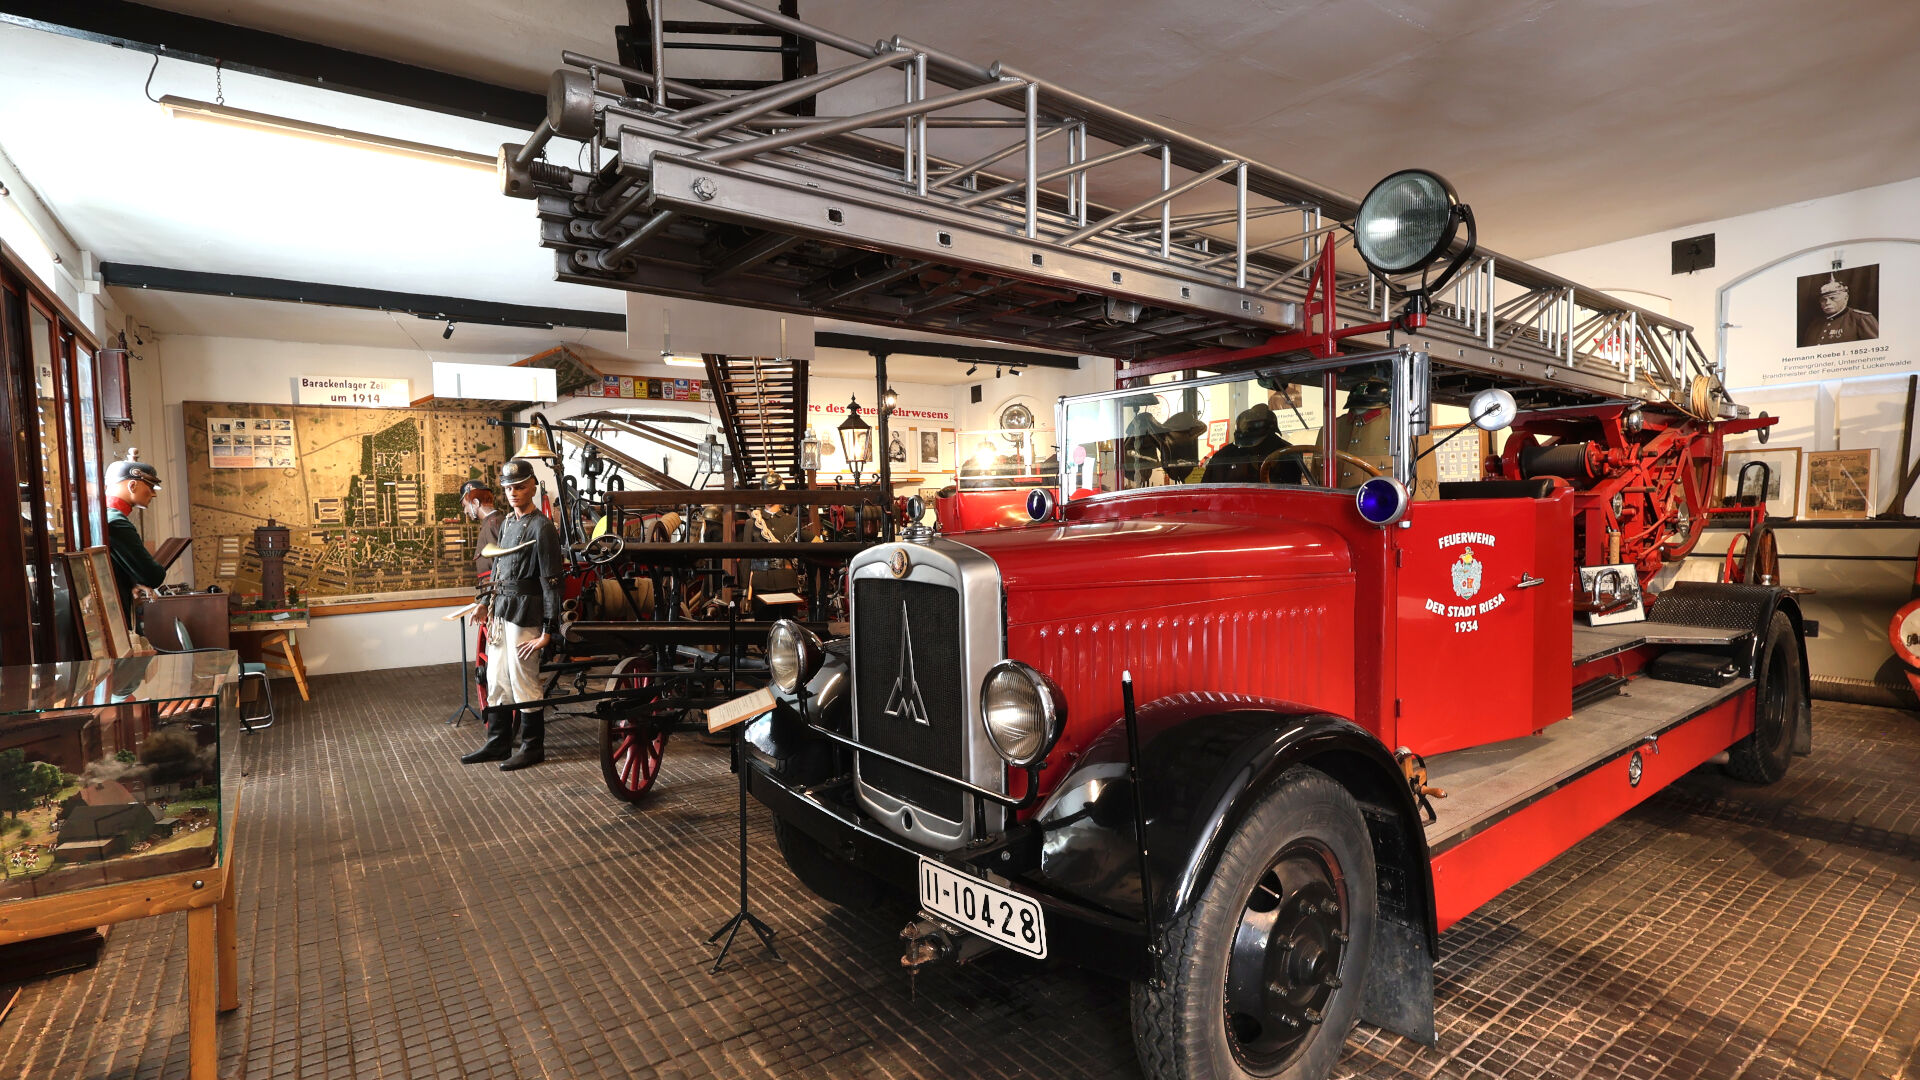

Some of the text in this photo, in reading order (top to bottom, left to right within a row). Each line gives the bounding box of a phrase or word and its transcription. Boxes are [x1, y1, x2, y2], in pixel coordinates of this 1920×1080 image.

[1850, 345, 1889, 355] 1852-1932
[1838, 356, 1886, 365] Unternehmer
[1762, 370, 1806, 379] Brandmeister
[1862, 360, 1912, 370] Luckenwalde
[302, 378, 367, 391] Barackenlager
[352, 394, 380, 403] 1914
[825, 404, 845, 413] des
[1438, 532, 1496, 549] FEUERWEHR
[1425, 593, 1506, 617] DER STADT RIESA
[1454, 620, 1478, 633] 1934
